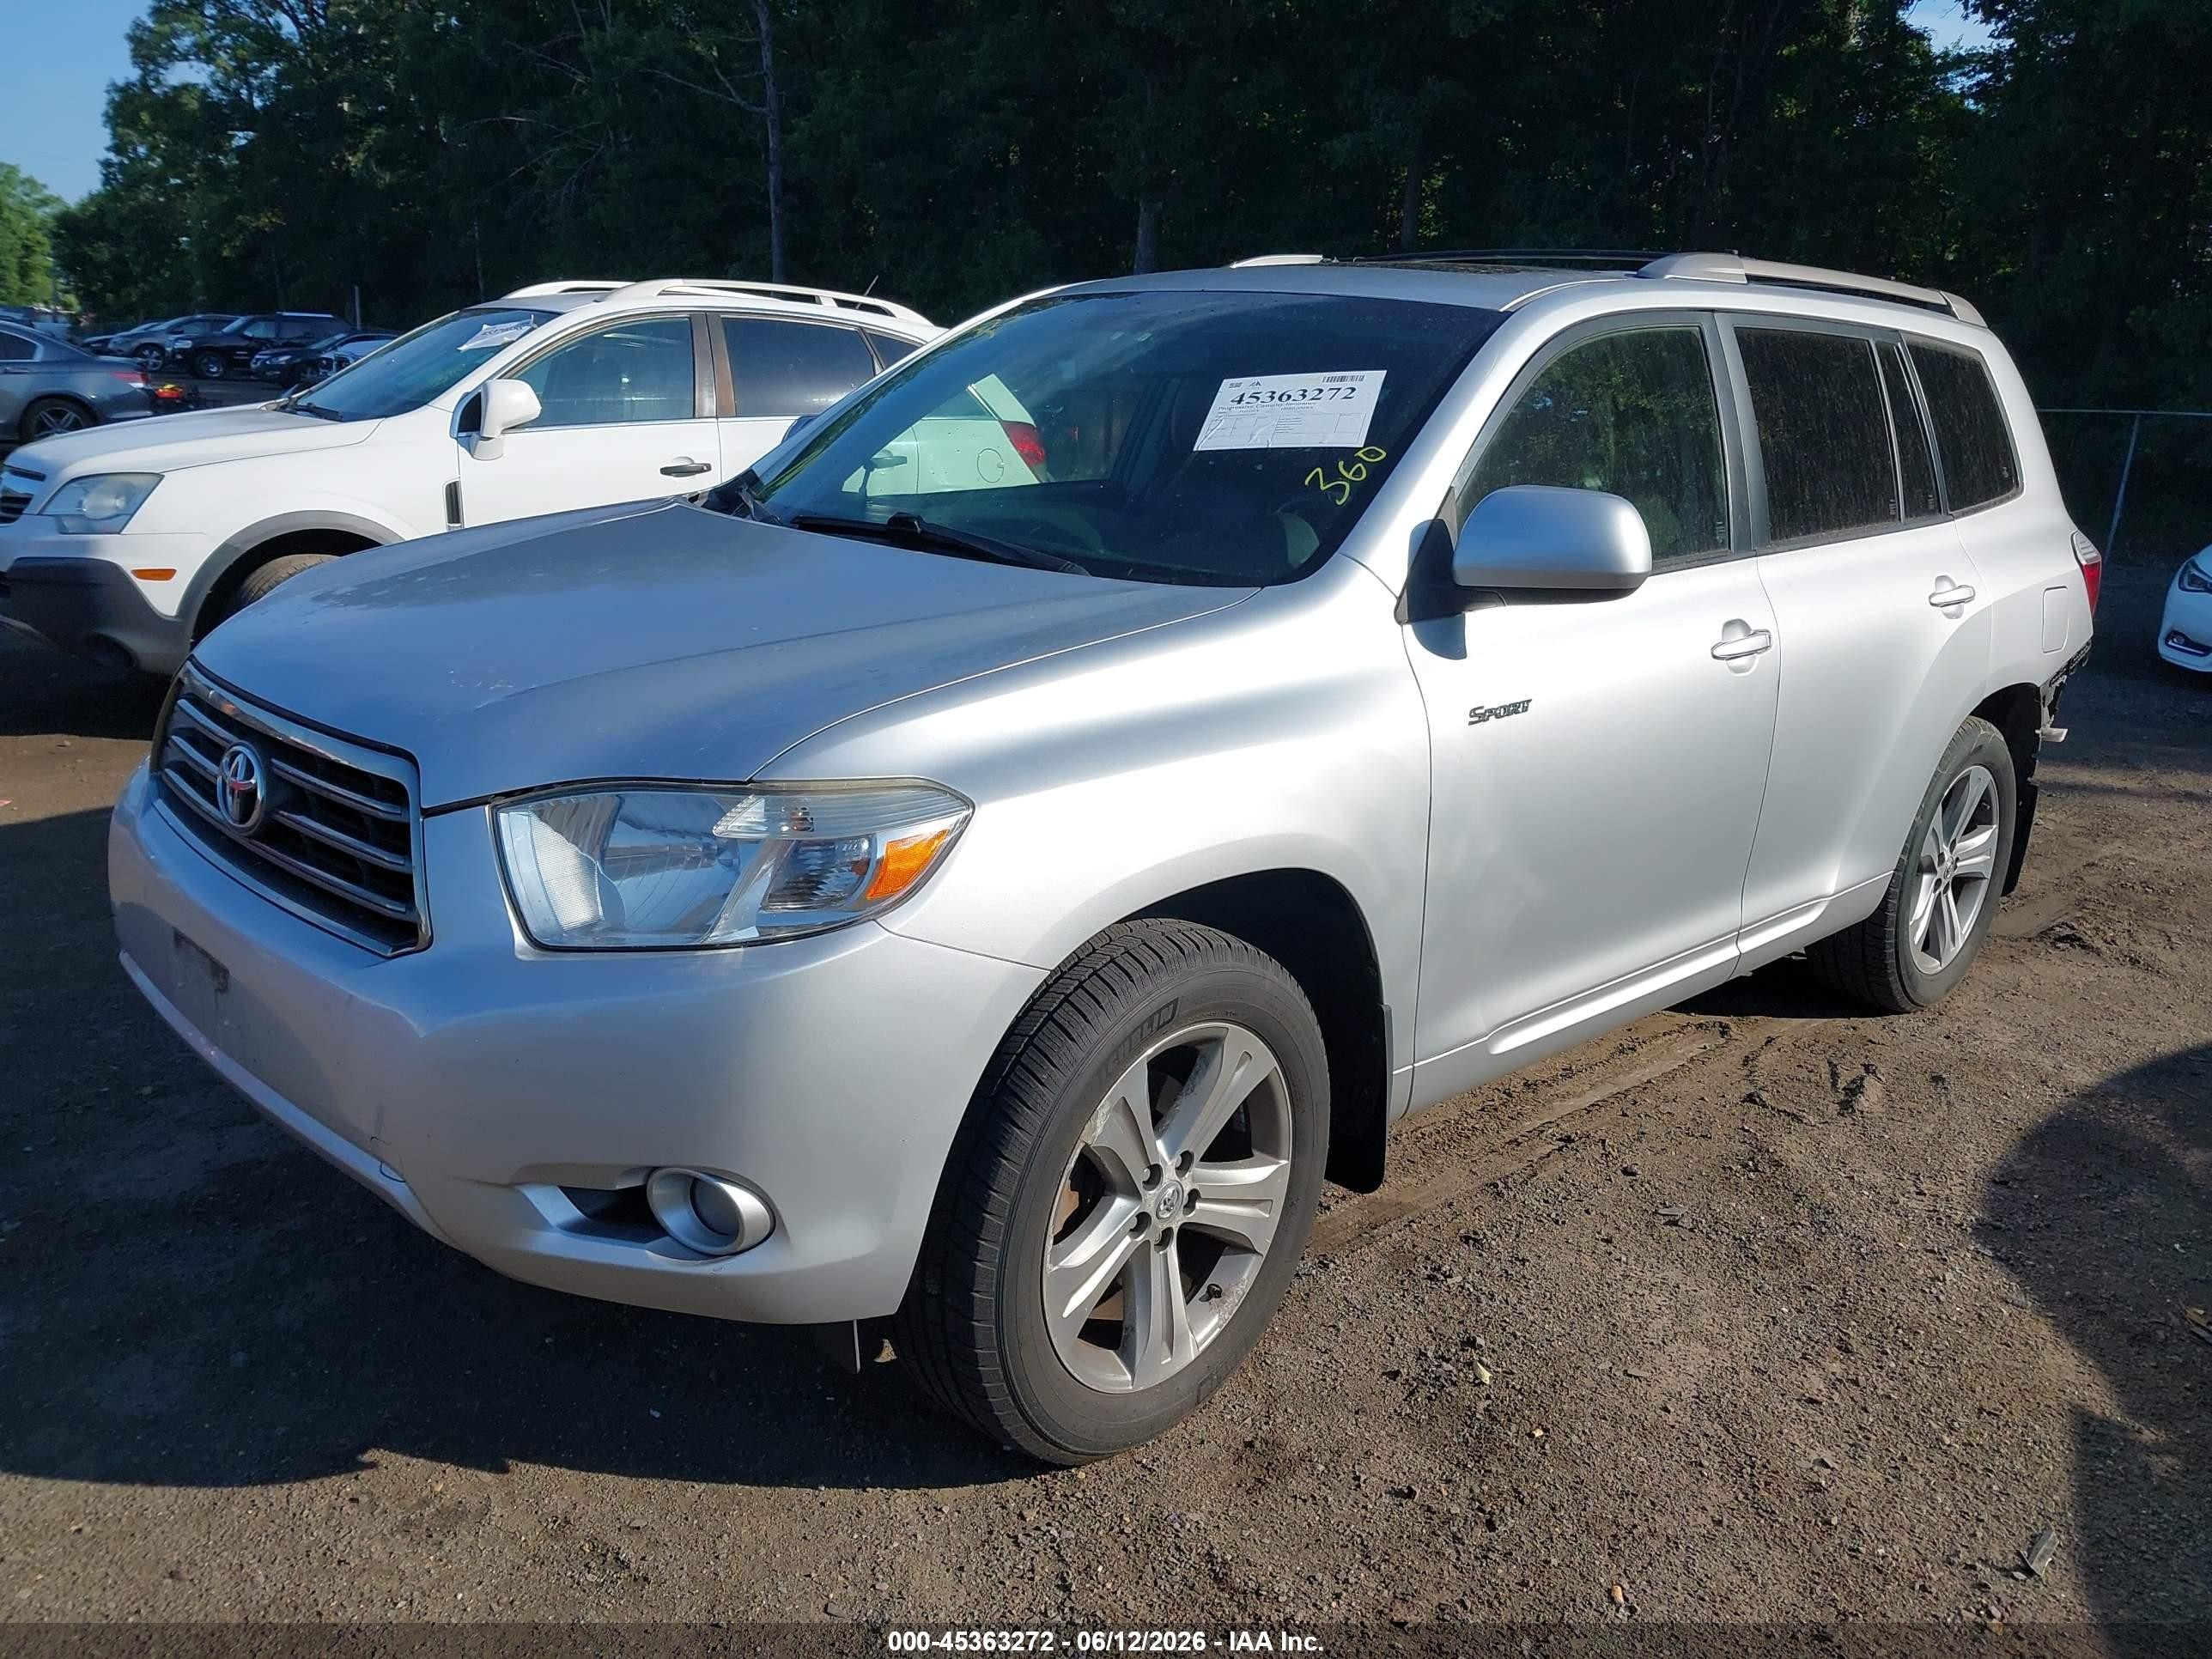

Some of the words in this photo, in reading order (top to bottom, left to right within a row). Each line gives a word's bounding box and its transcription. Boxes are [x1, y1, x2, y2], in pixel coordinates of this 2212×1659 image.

[1230, 386, 1357, 405] 45363272
[1304, 446, 1387, 506] 360
[1089, 1003, 1175, 1091] ICHELIN
